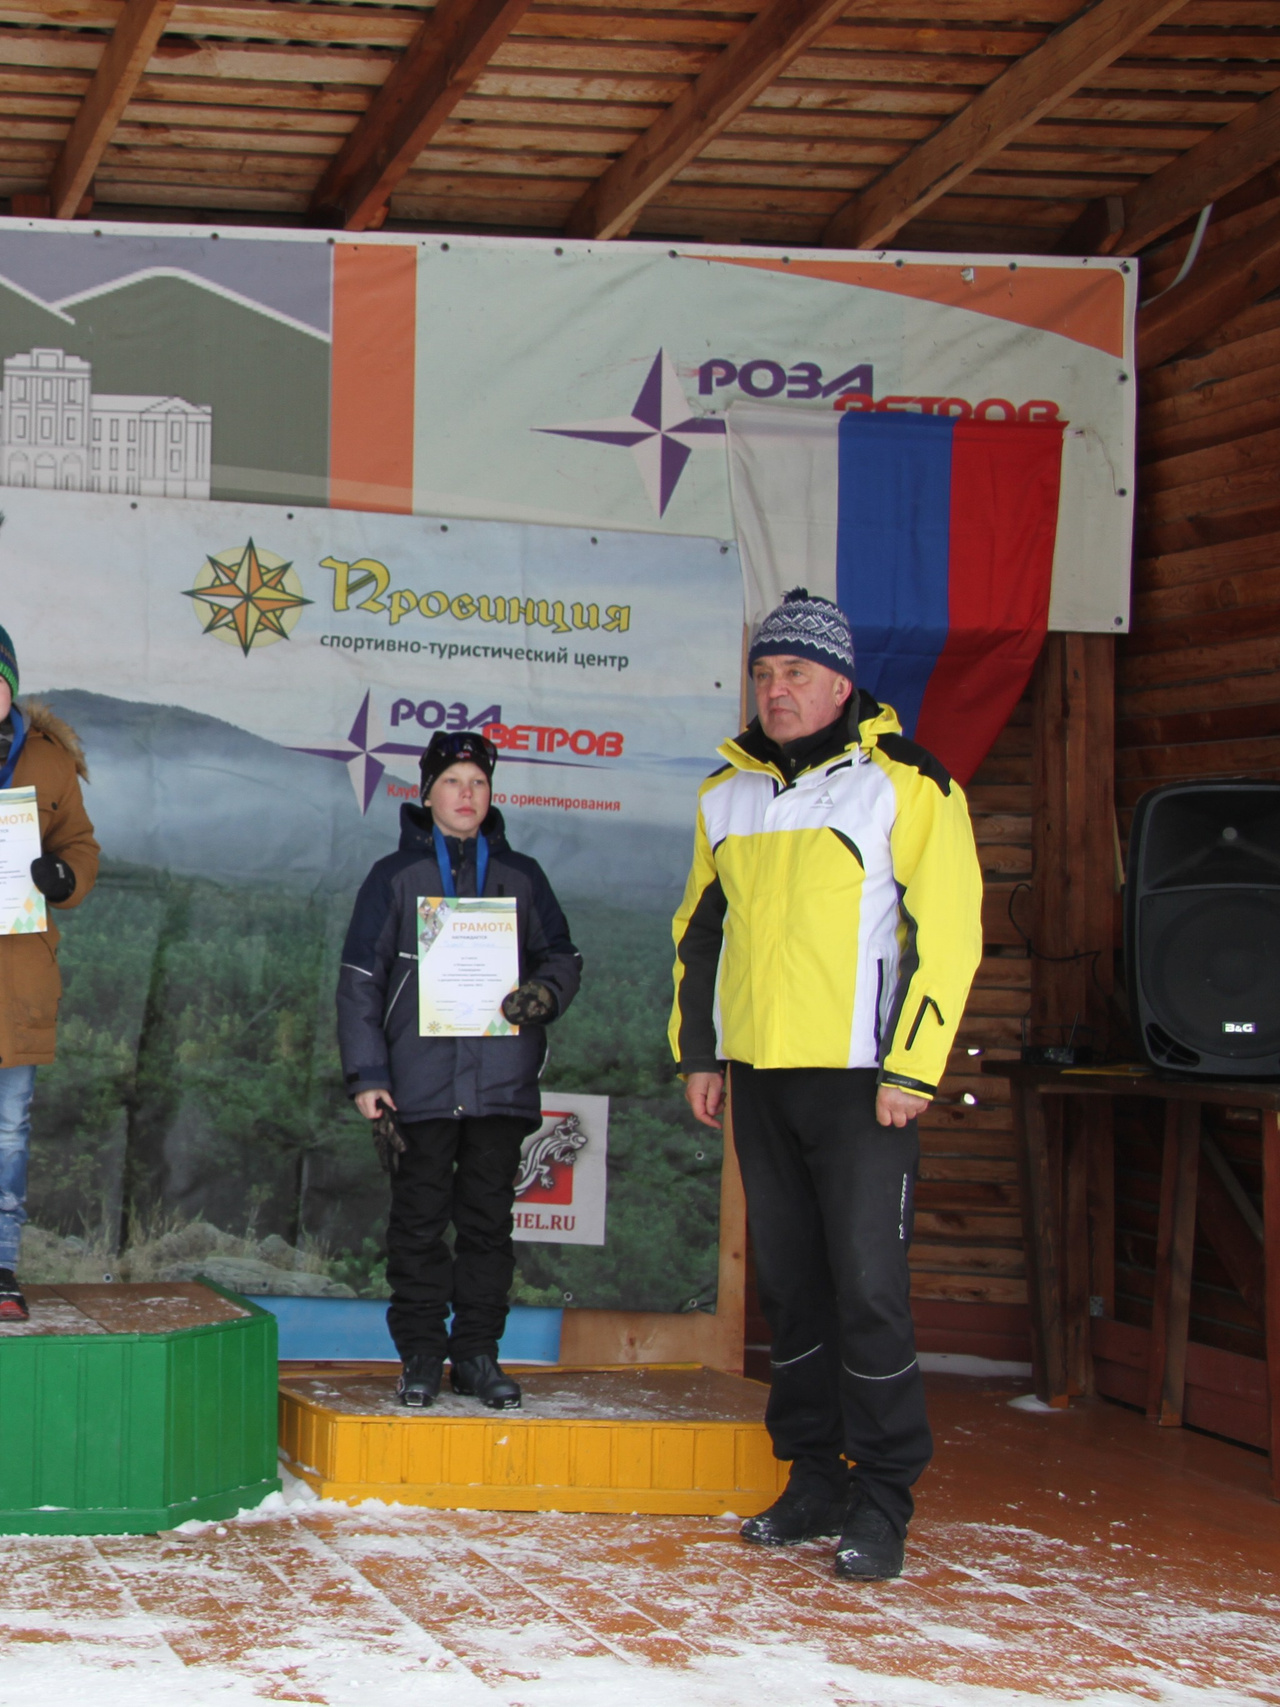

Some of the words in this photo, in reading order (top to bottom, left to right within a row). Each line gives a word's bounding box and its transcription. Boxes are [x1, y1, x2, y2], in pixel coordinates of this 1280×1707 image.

[698, 359, 873, 398] РОЗА
[319, 555, 631, 633] Провинция
[320, 634, 568, 665] спортивно-туристический
[574, 651, 629, 671] центр
[390, 698, 502, 731] РОЗА
[482, 723, 624, 757] ВЕТРОВ
[387, 783, 420, 801] Клуб
[510, 792, 621, 811] ориентирования
[452, 922, 514, 932] ГРАМОТА
[1224, 1023, 1253, 1033] B&G
[511, 1212, 576, 1231] HEL.RU
